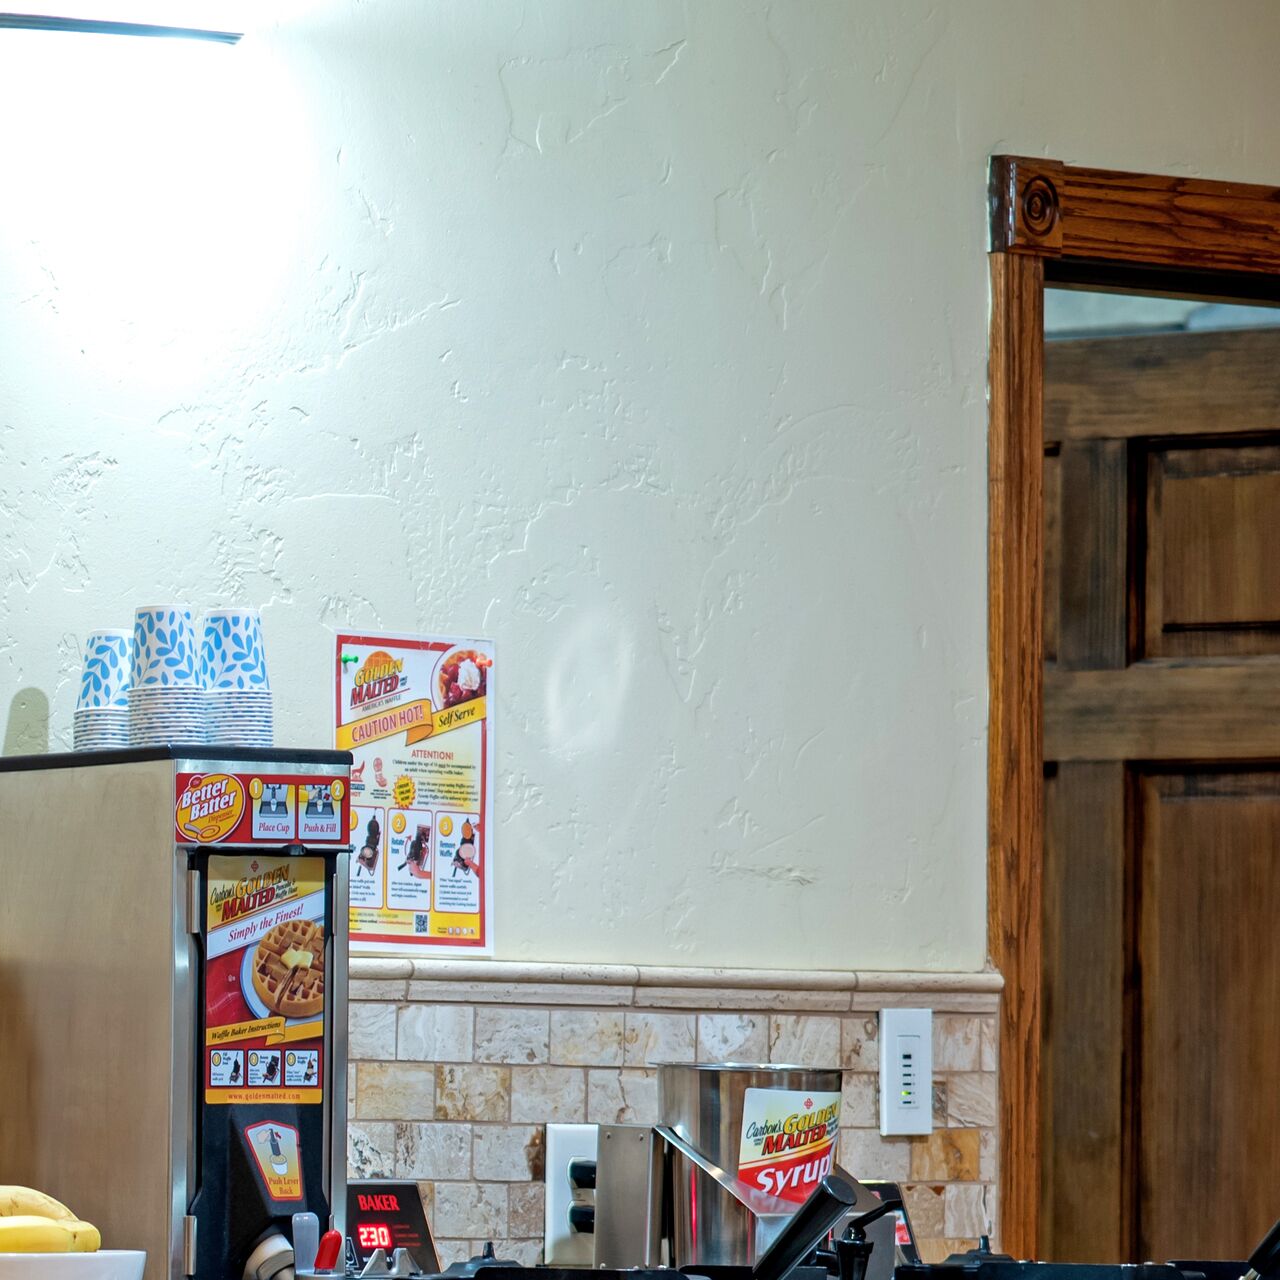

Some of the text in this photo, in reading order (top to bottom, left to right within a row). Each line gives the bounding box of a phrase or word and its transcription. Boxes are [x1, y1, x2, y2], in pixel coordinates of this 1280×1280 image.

[354, 657, 404, 686] GOLDEN
[350, 675, 399, 706] MALTED
[352, 704, 423, 743] CAUTION HOT!
[438, 706, 475, 728] Self Serve
[411, 749, 454, 760] ATTENTION!
[181, 779, 230, 809] Better
[253, 782, 258, 794] 1
[335, 784, 340, 796] 2
[190, 791, 237, 821] Batter
[258, 823, 290, 834] Place Cup
[304, 823, 319, 832] Push
[325, 823, 336, 833] Fill
[236, 864, 290, 898] GOLDEN
[222, 887, 276, 921] MALTED
[228, 903, 304, 943] Simply the Finest!
[211, 1022, 280, 1040] Waffle Baker Instructions
[228, 1093, 301, 1101] www.goldenmalted.com
[783, 1102, 838, 1135] GOLDEN
[761, 1123, 827, 1156] MALTED
[756, 1154, 830, 1196] Syrup
[357, 1194, 400, 1211] BAKER
